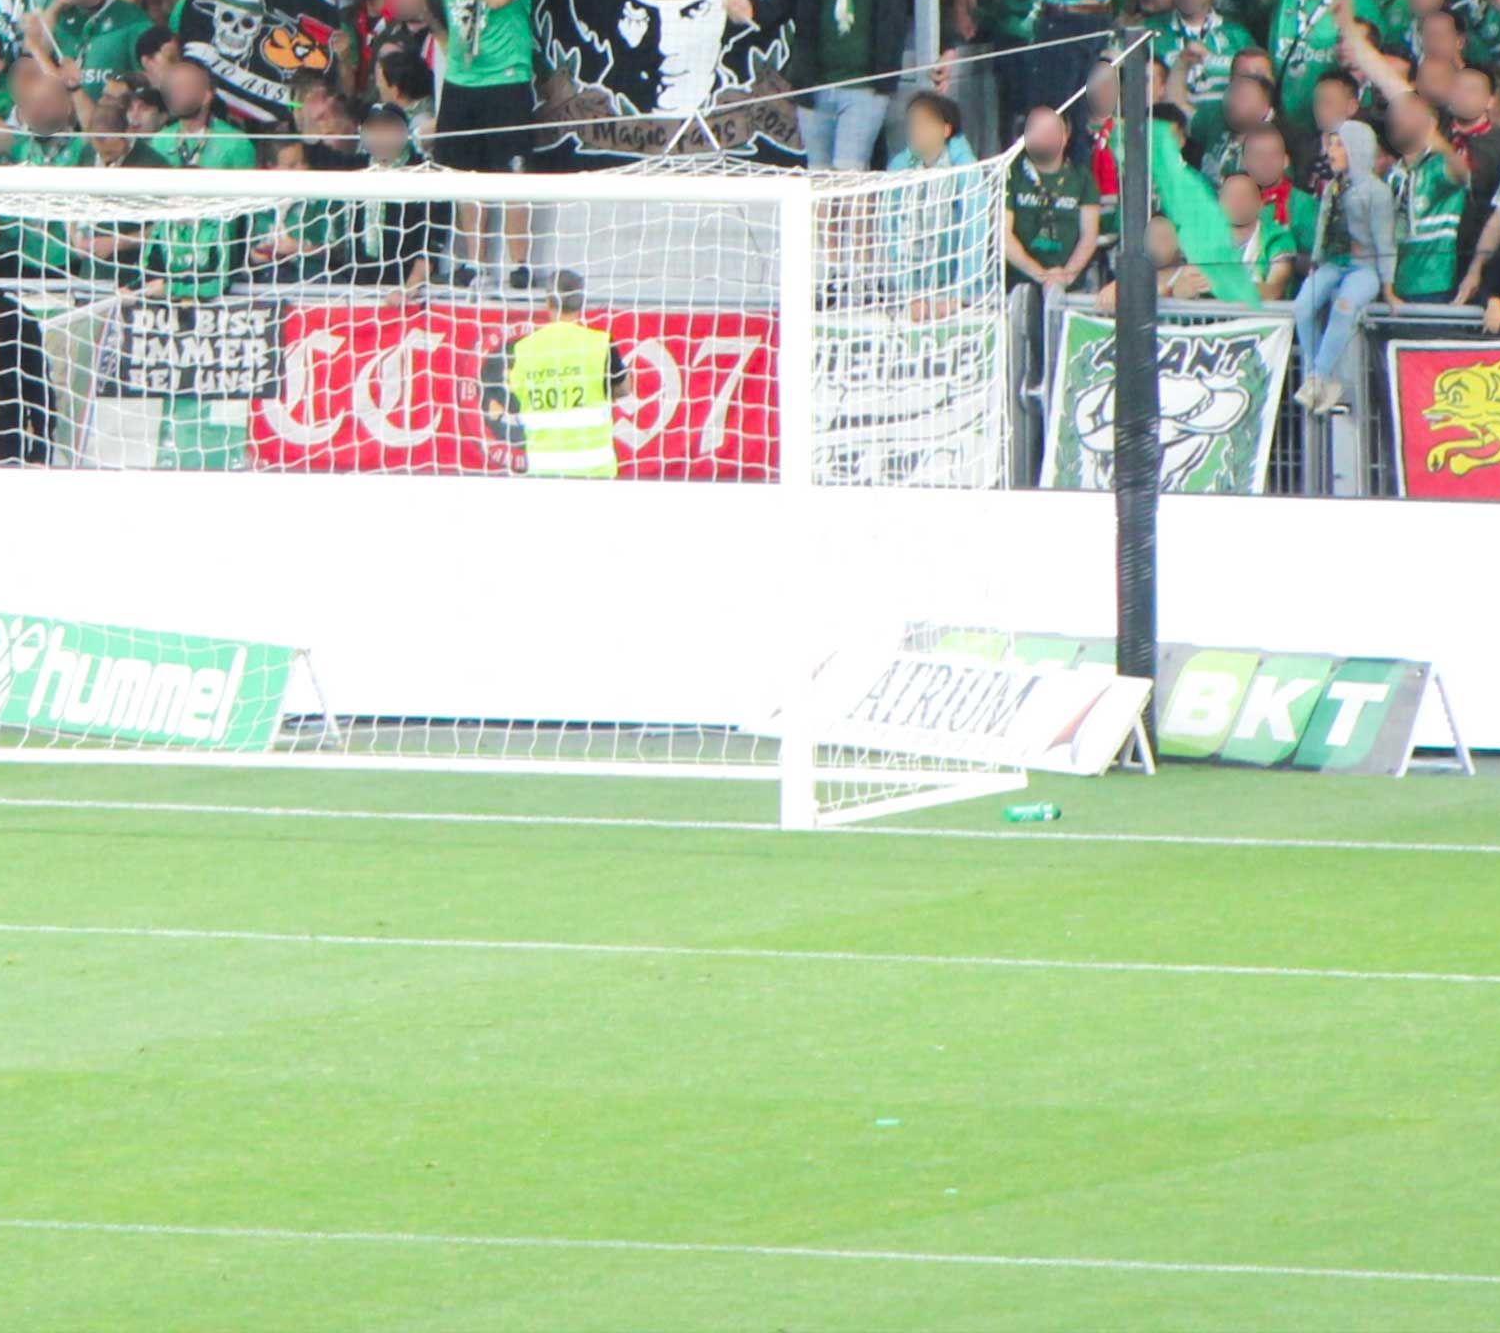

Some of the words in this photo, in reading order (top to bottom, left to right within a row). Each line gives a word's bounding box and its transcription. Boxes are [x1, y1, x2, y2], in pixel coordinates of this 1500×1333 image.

[131, 339, 269, 367] IMMER
[28, 645, 246, 742] hummel
[847, 659, 1043, 738] ATRIUM
[1180, 670, 1388, 747] BKT
